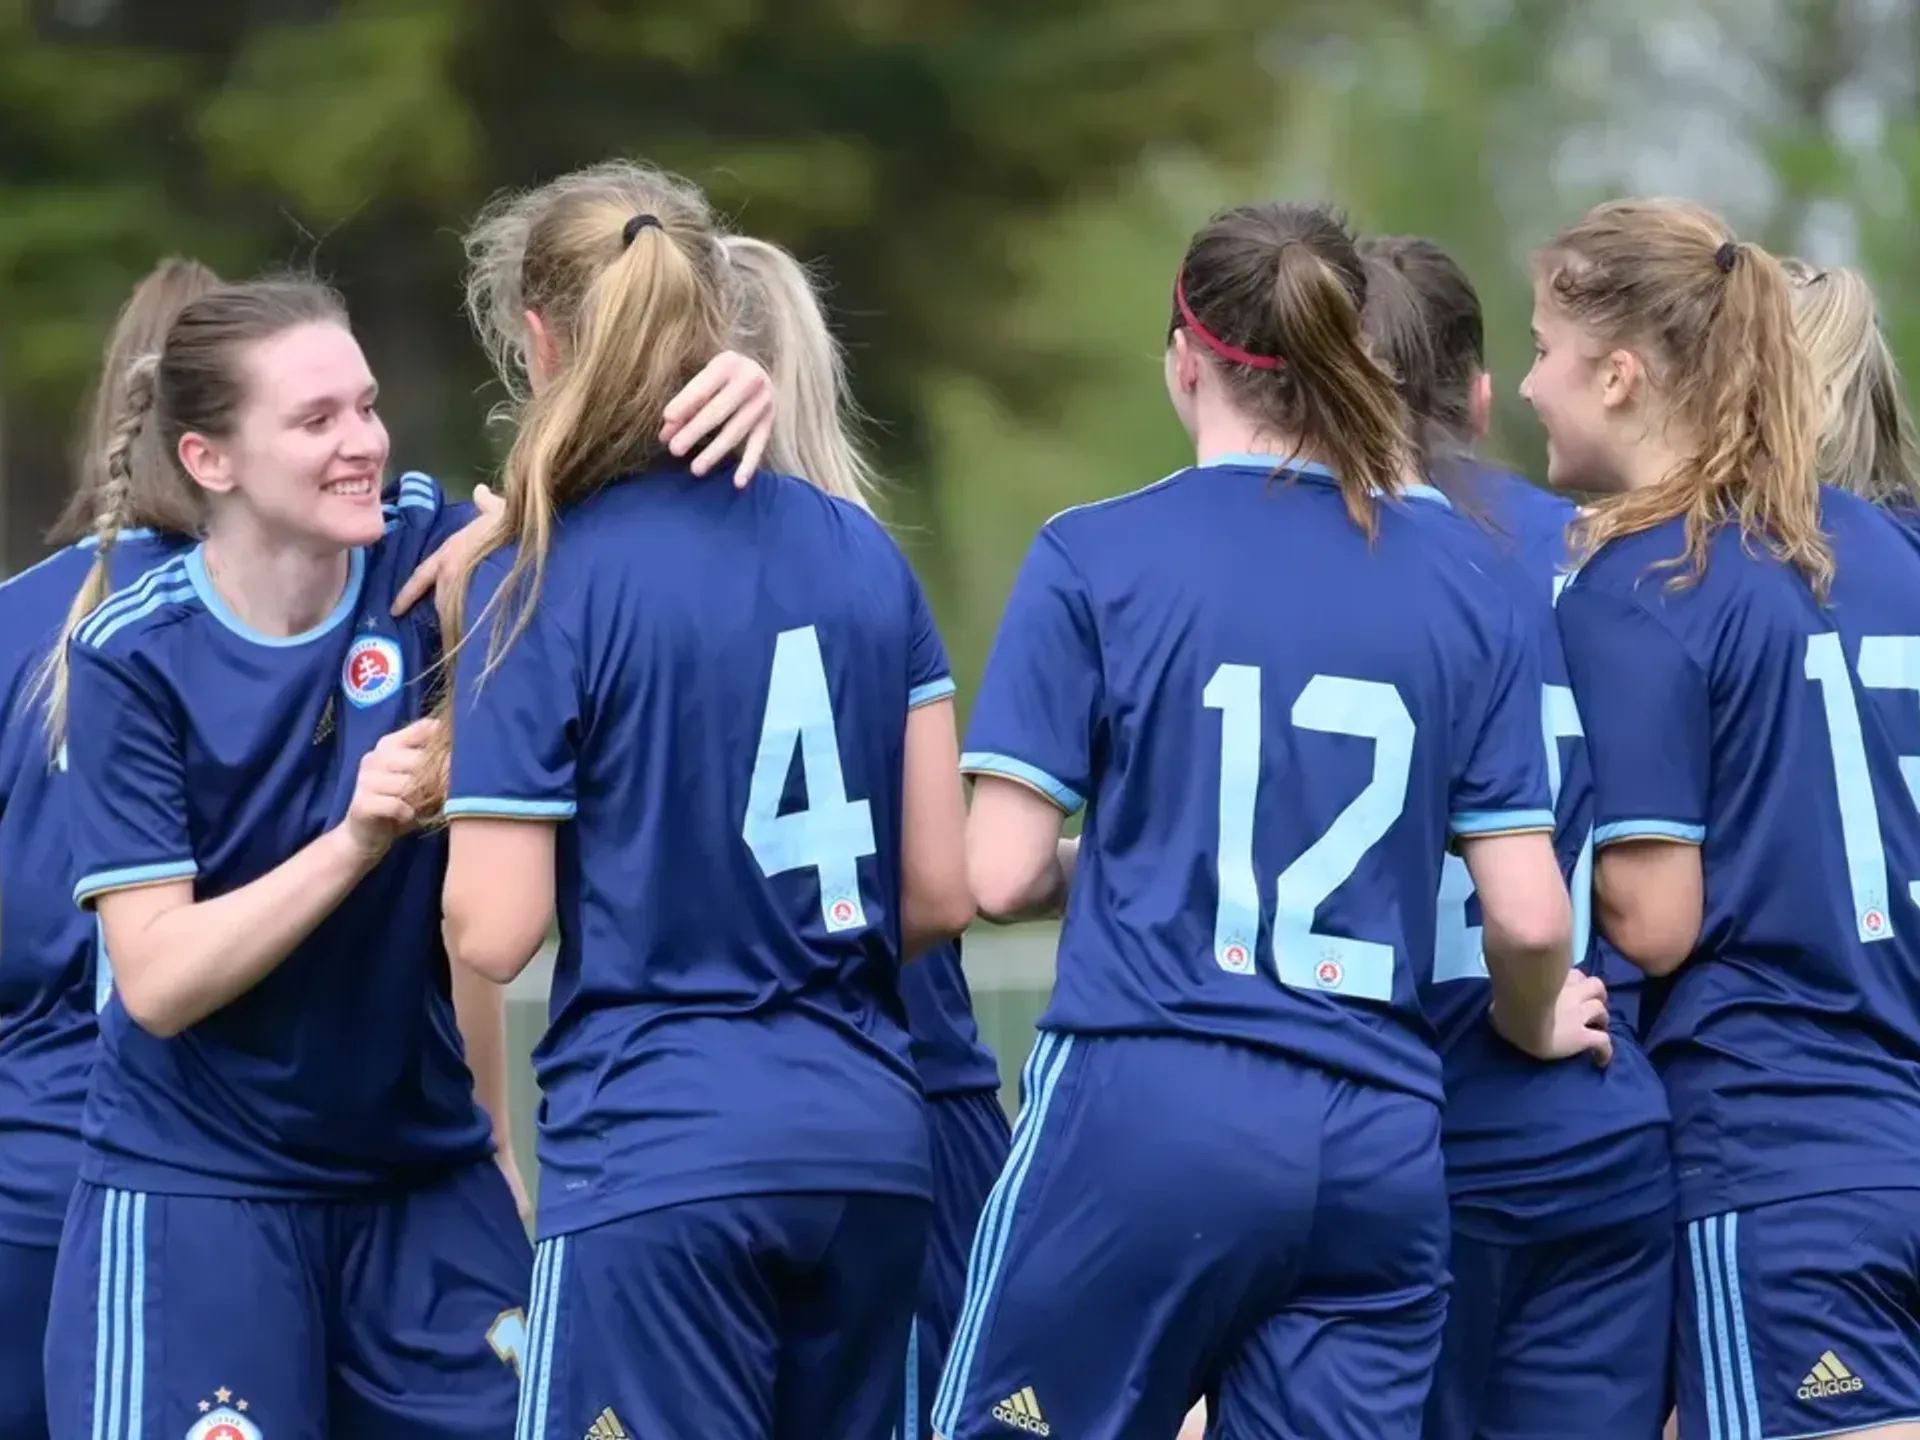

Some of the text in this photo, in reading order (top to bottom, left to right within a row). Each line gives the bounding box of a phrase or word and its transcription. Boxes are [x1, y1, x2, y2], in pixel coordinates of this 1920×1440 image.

[742, 625, 877, 933] 4
[1203, 663, 1416, 1001] 12
[992, 1406, 1050, 1436] adidas
[1797, 1376, 1863, 1400] adidas
